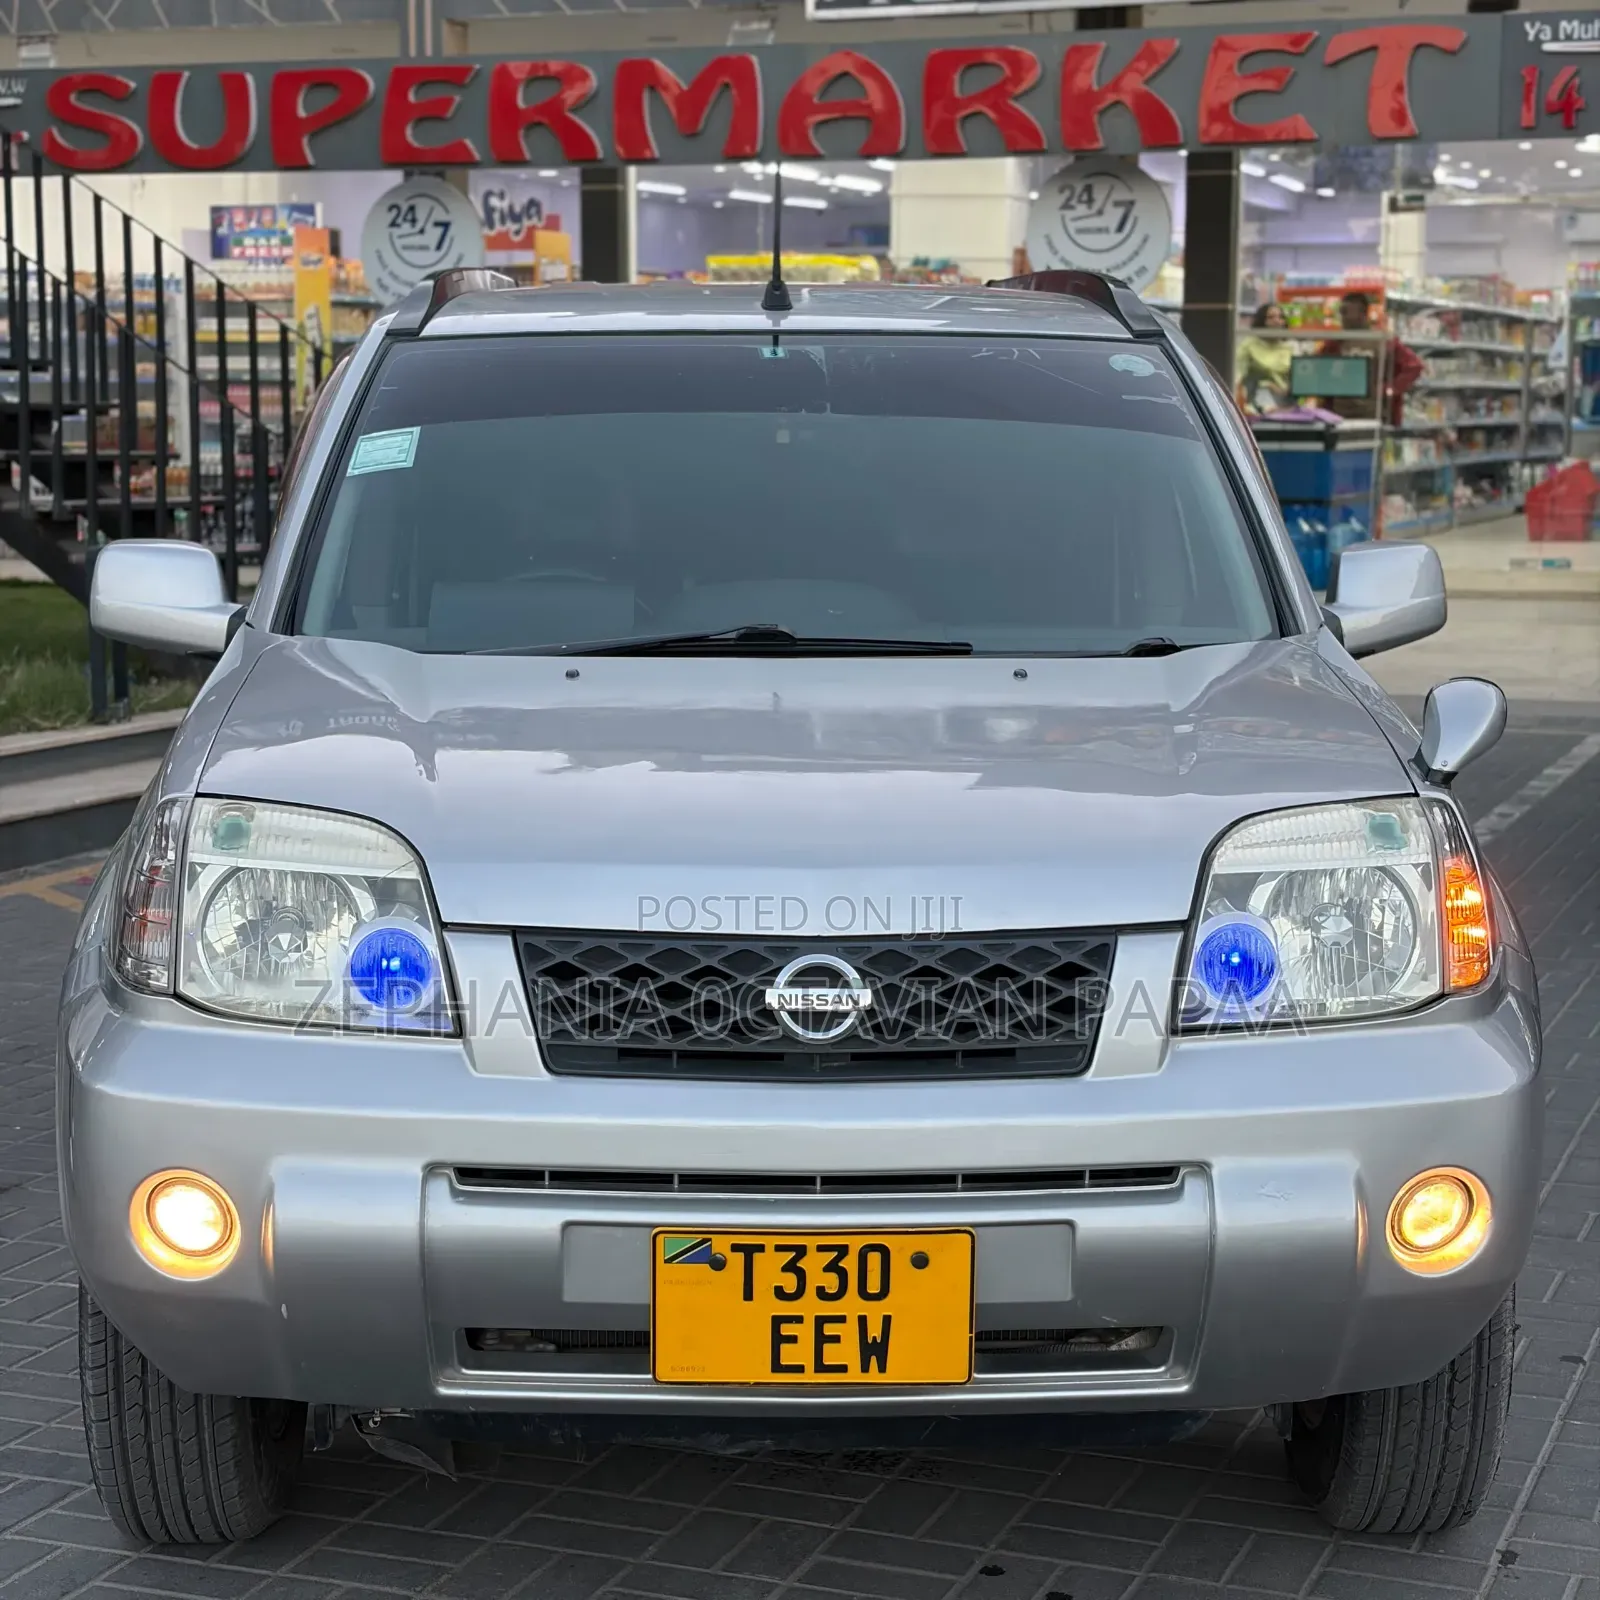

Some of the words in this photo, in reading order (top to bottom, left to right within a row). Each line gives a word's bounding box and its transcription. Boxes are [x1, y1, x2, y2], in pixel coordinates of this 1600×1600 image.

[1524, 21, 1551, 41] Ya
[41, 24, 1468, 171] SUPERMARKET
[1520, 64, 1585, 129] 14
[777, 993, 861, 1007] NISSAN
[729, 1242, 892, 1302] T330
[770, 1313, 892, 1374] EEW
